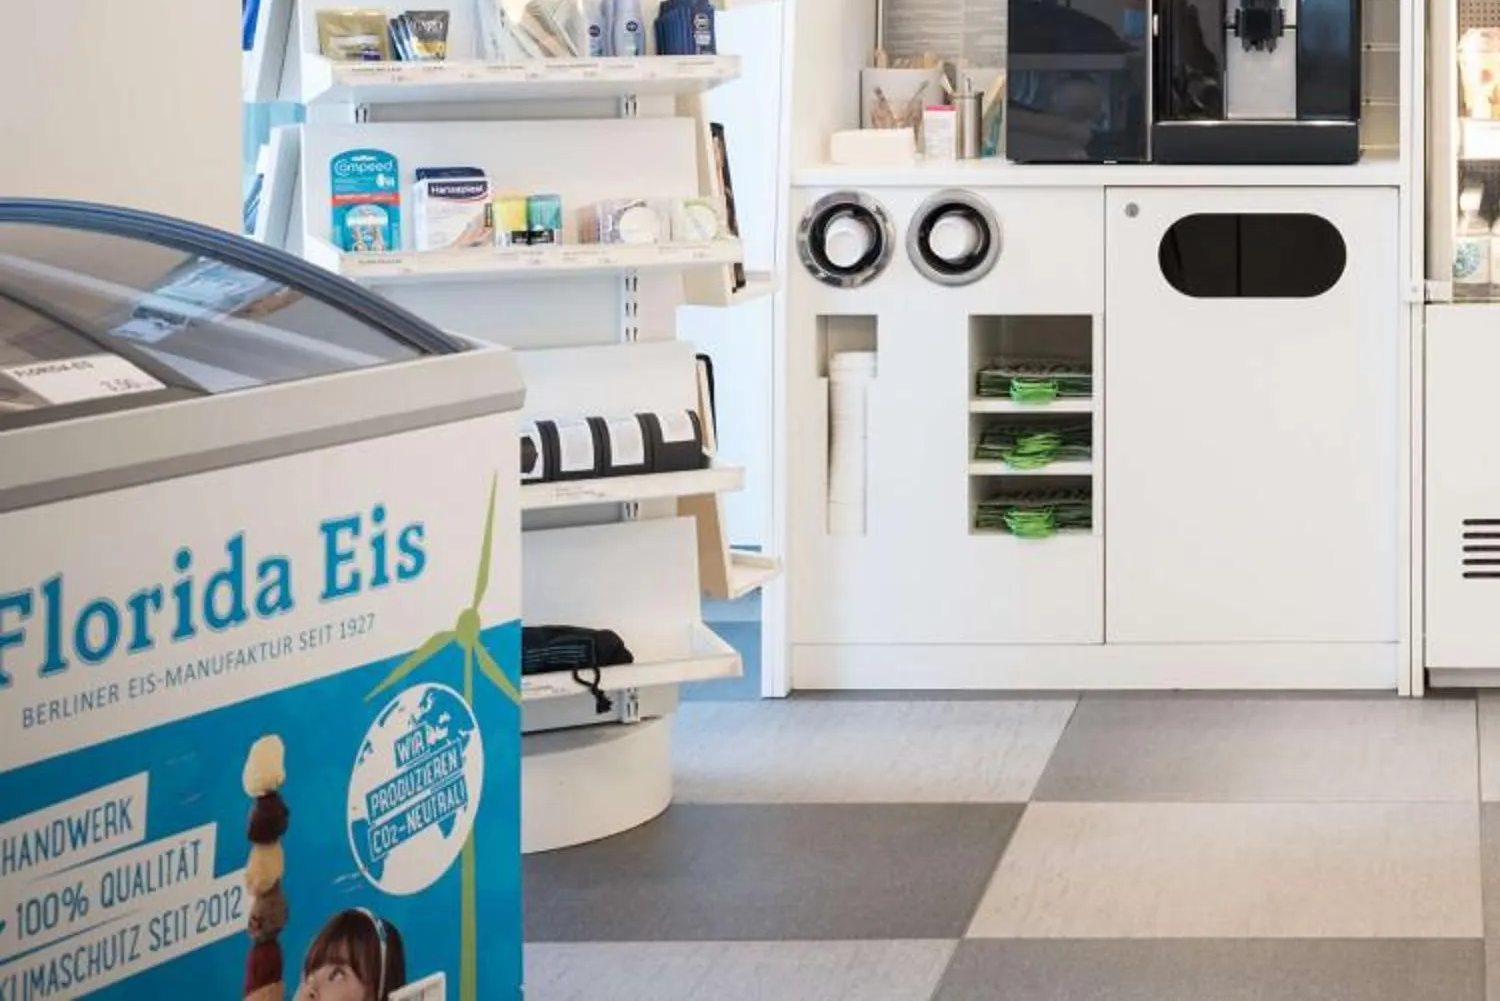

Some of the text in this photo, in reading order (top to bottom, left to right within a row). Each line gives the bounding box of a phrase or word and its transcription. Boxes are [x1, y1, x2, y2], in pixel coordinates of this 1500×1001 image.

[334, 159, 394, 177] Compeed
[430, 184, 485, 195] Hansaplast
[0, 503, 428, 687] Florida Eis
[22, 613, 377, 729] BERLINER EIS-MANUFAKTUR SEIT 1927
[370, 745, 460, 819] PRODUZIEREN
[396, 730, 425, 764] WIR
[1, 796, 134, 877] HANDWERK
[16, 839, 202, 940] 100% QUALITÄT
[149, 904, 190, 952] SEIT
[195, 886, 243, 934] 2012
